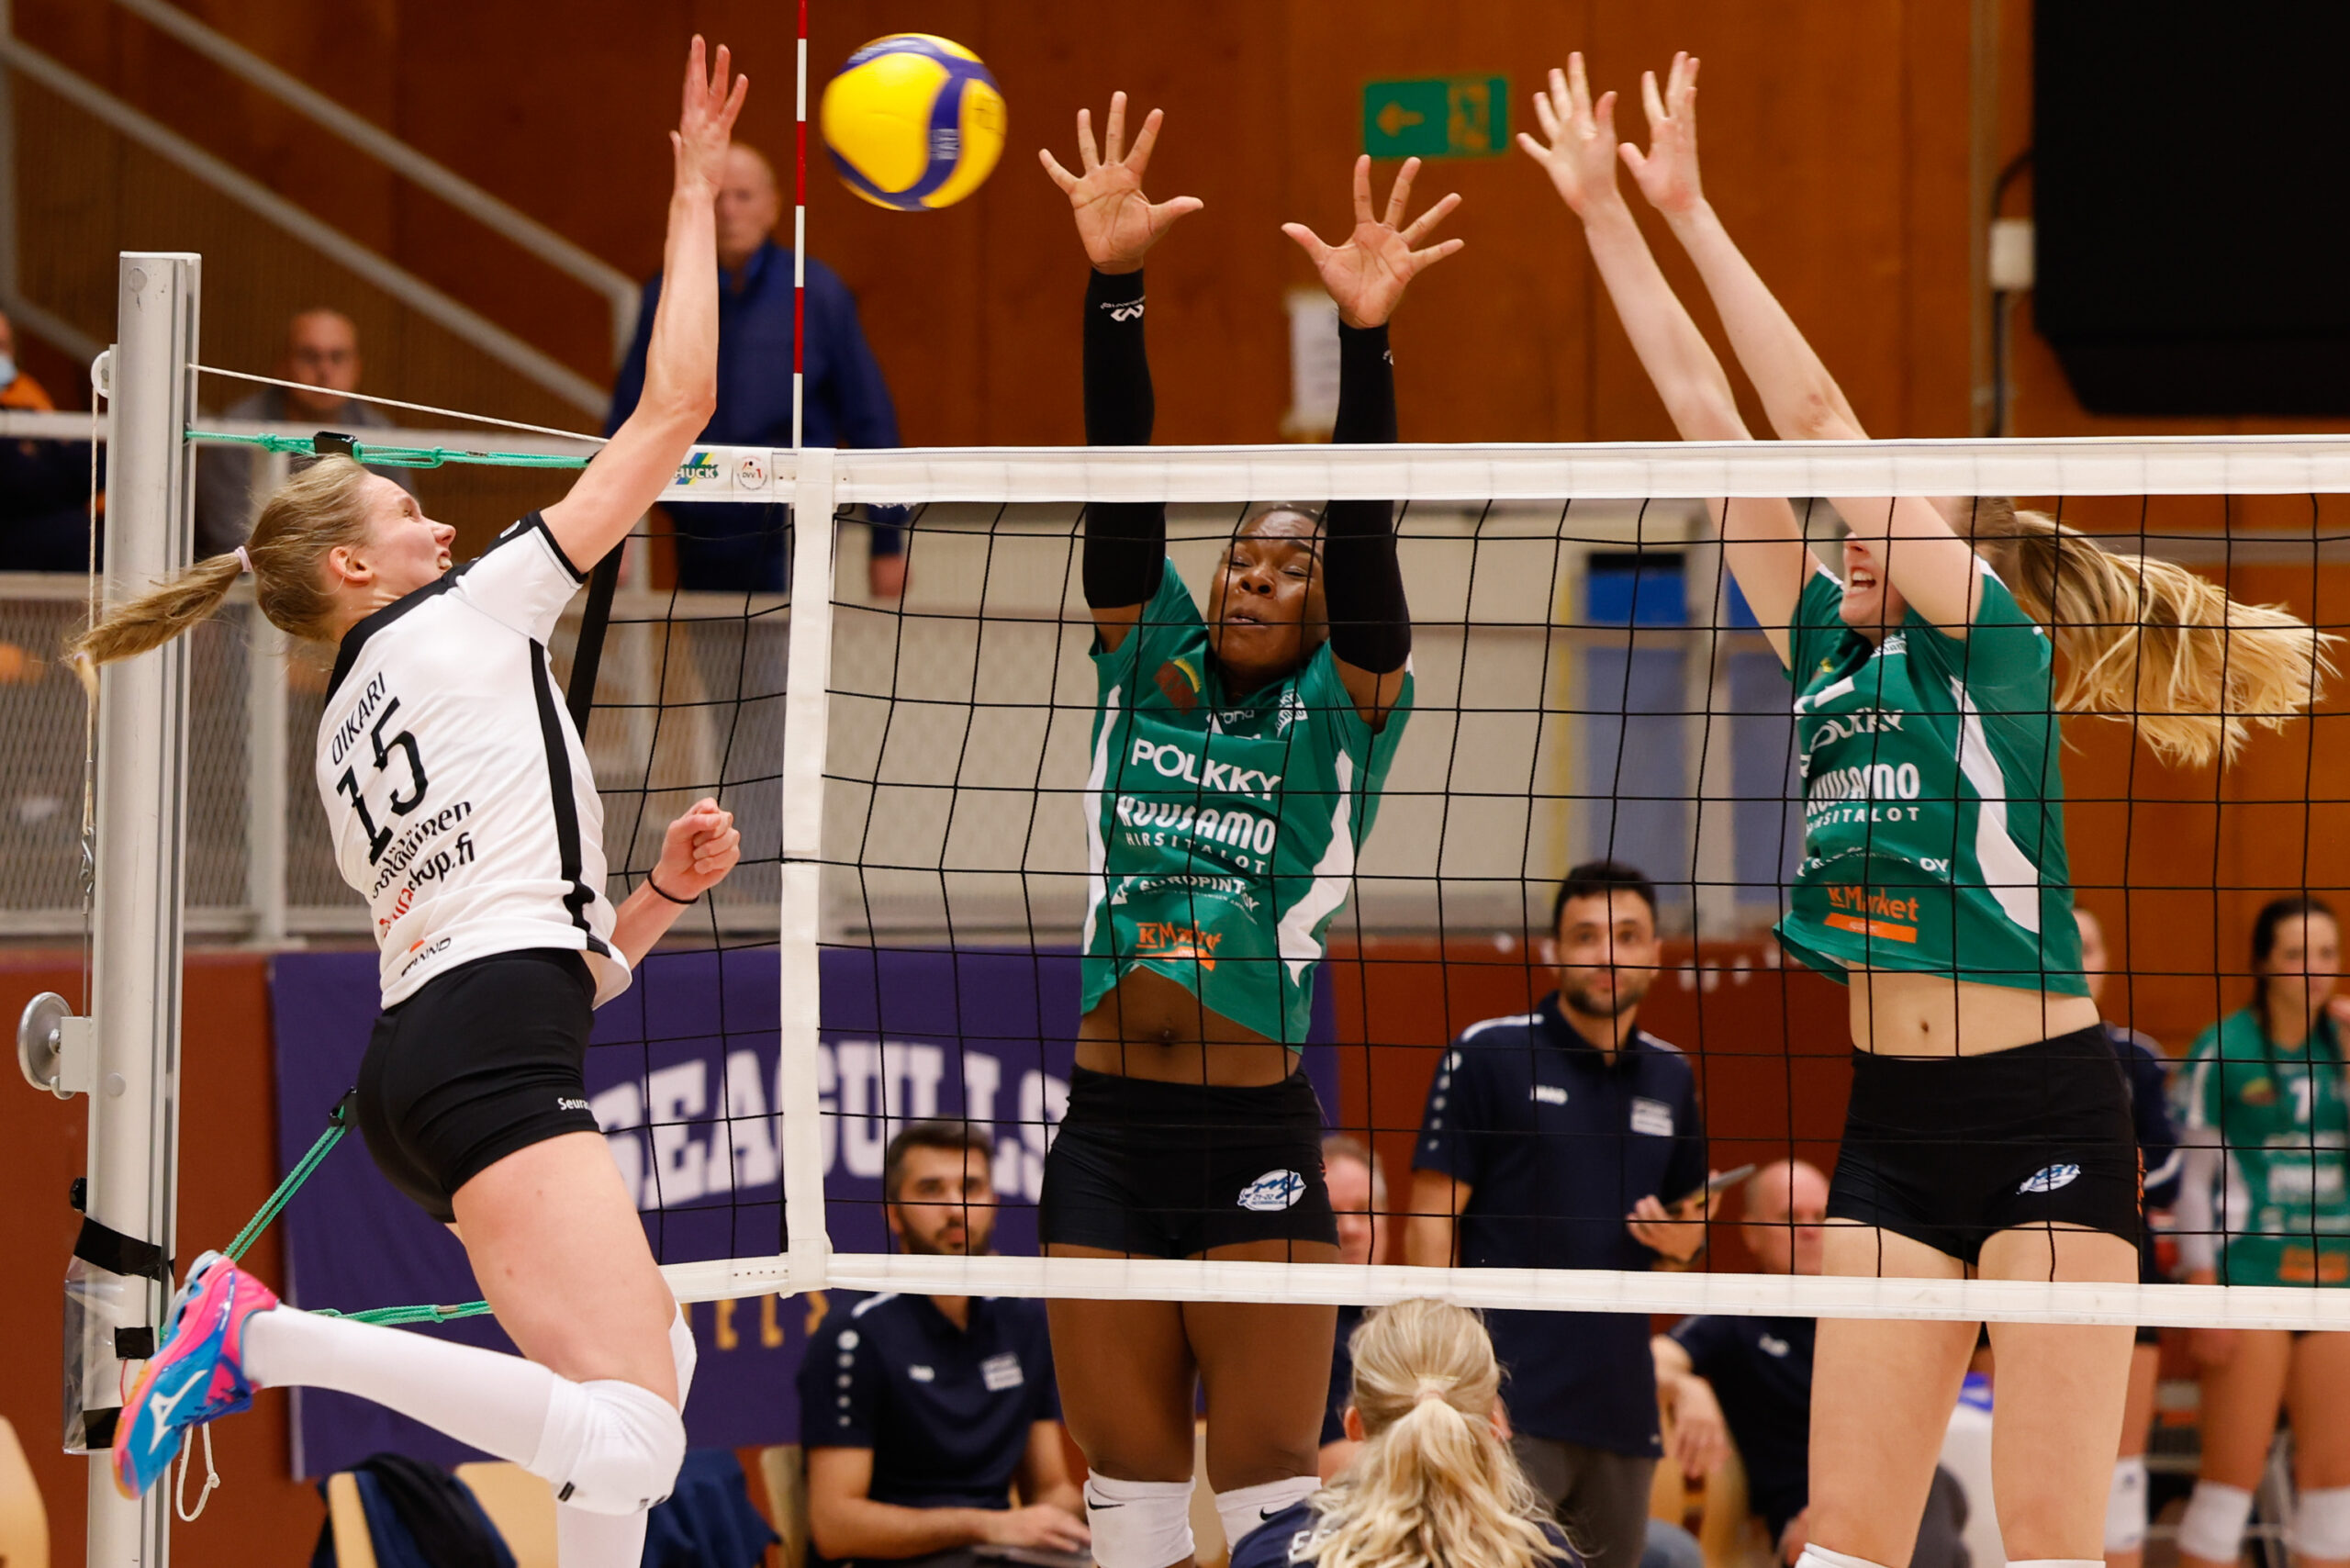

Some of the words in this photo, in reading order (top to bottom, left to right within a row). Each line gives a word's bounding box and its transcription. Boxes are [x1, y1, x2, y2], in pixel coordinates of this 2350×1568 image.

[674, 465, 719, 479] HUCK
[331, 671, 386, 766] OIKARI
[336, 696, 429, 867] 15
[1116, 794, 1279, 856] KUUSAMO
[1125, 831, 1267, 874] HIRSITALOT
